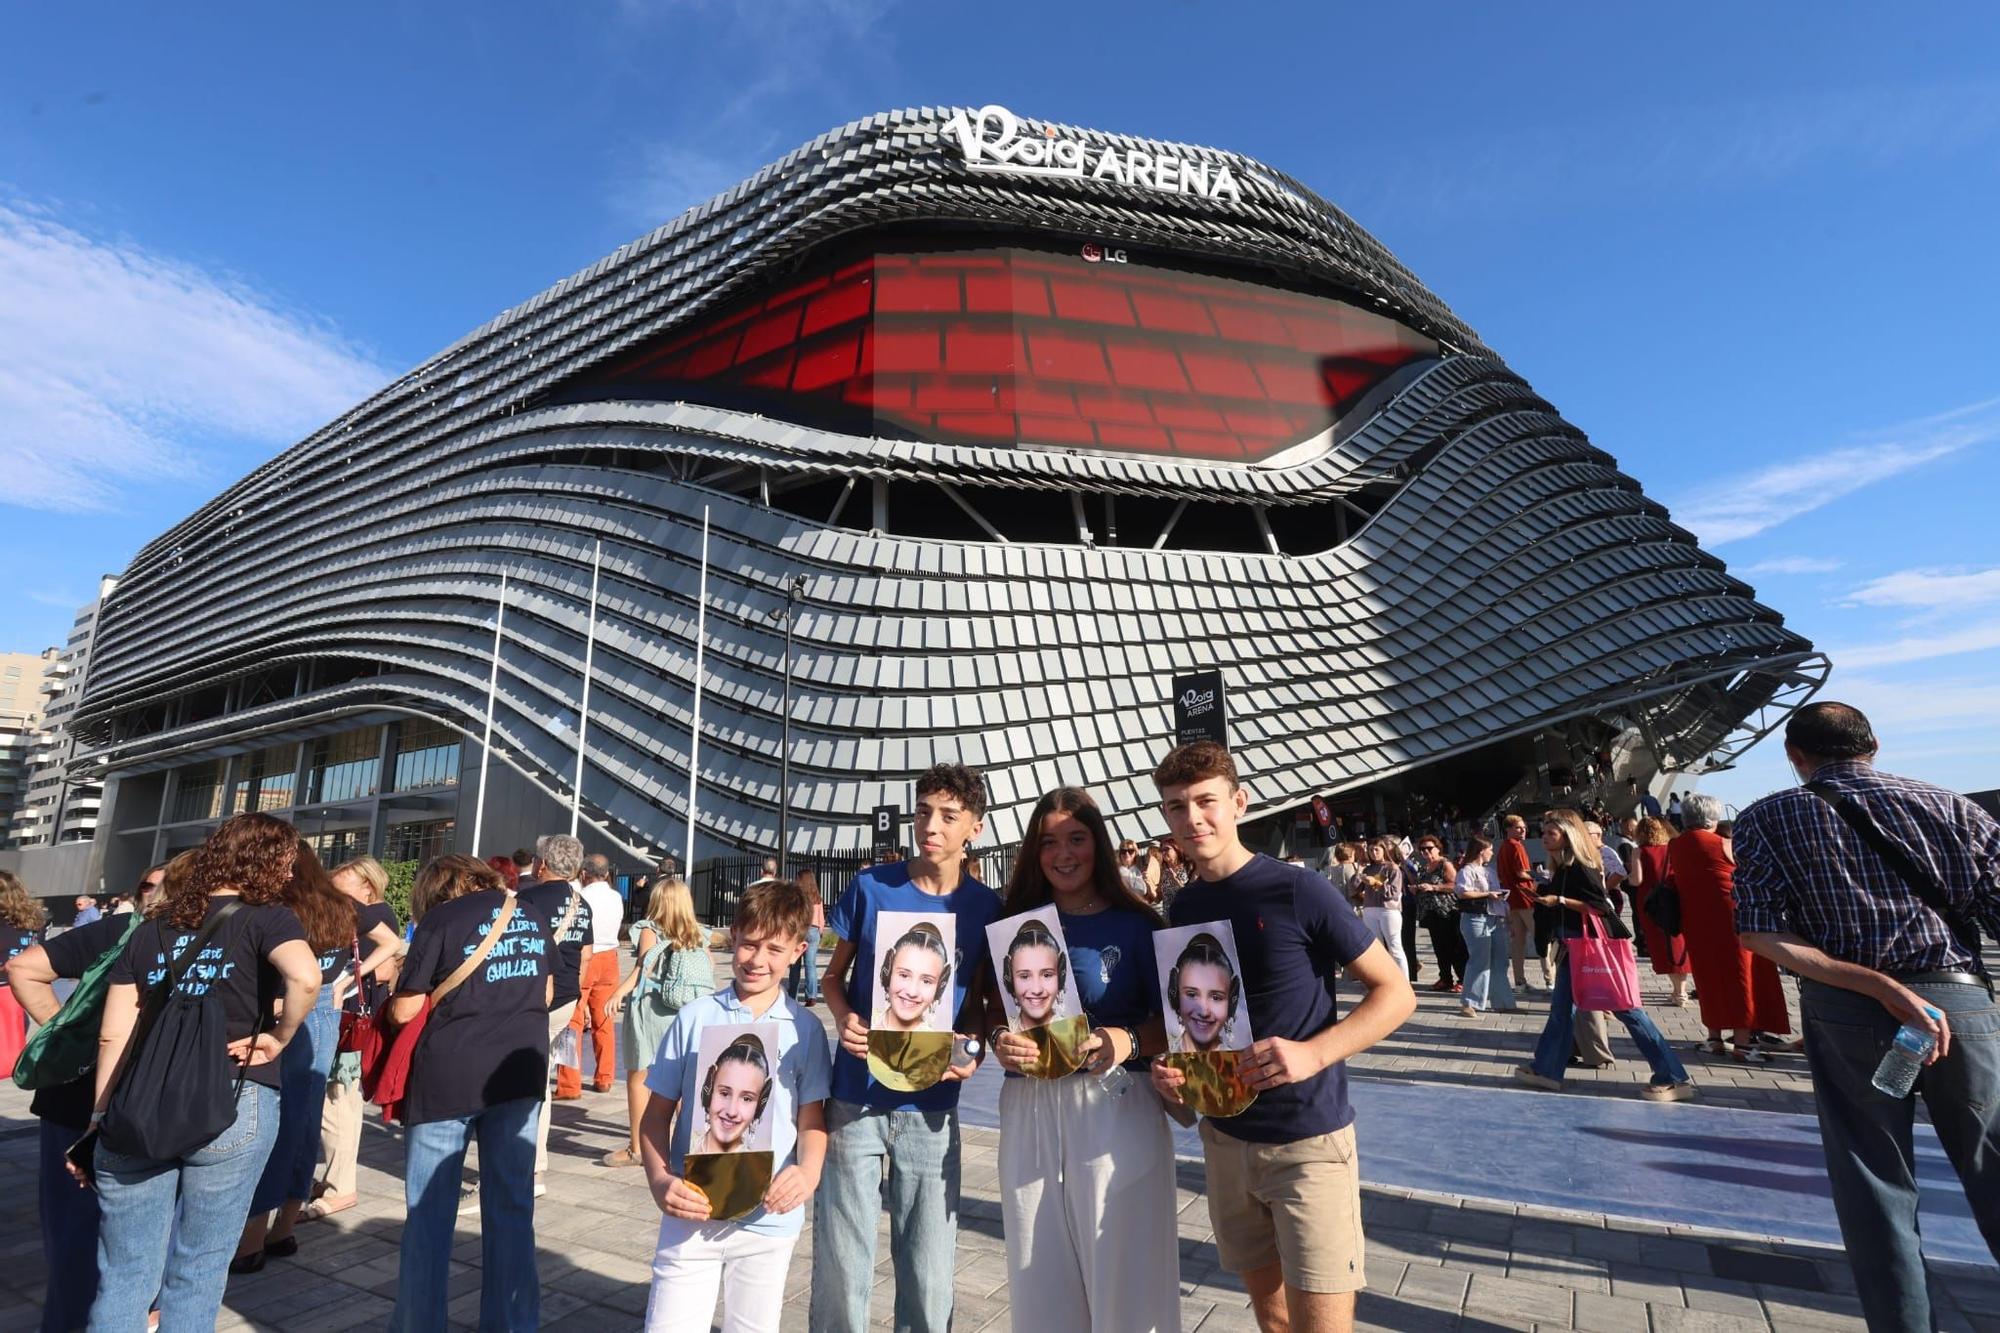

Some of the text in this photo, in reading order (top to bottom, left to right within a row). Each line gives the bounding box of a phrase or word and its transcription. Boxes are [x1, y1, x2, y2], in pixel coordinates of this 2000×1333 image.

[940, 105, 1241, 201] Roig ARENA
[1104, 247, 1128, 264] LG
[1179, 688, 1214, 710] Roig
[1187, 702, 1215, 718] ARENA
[879, 812, 890, 831] B
